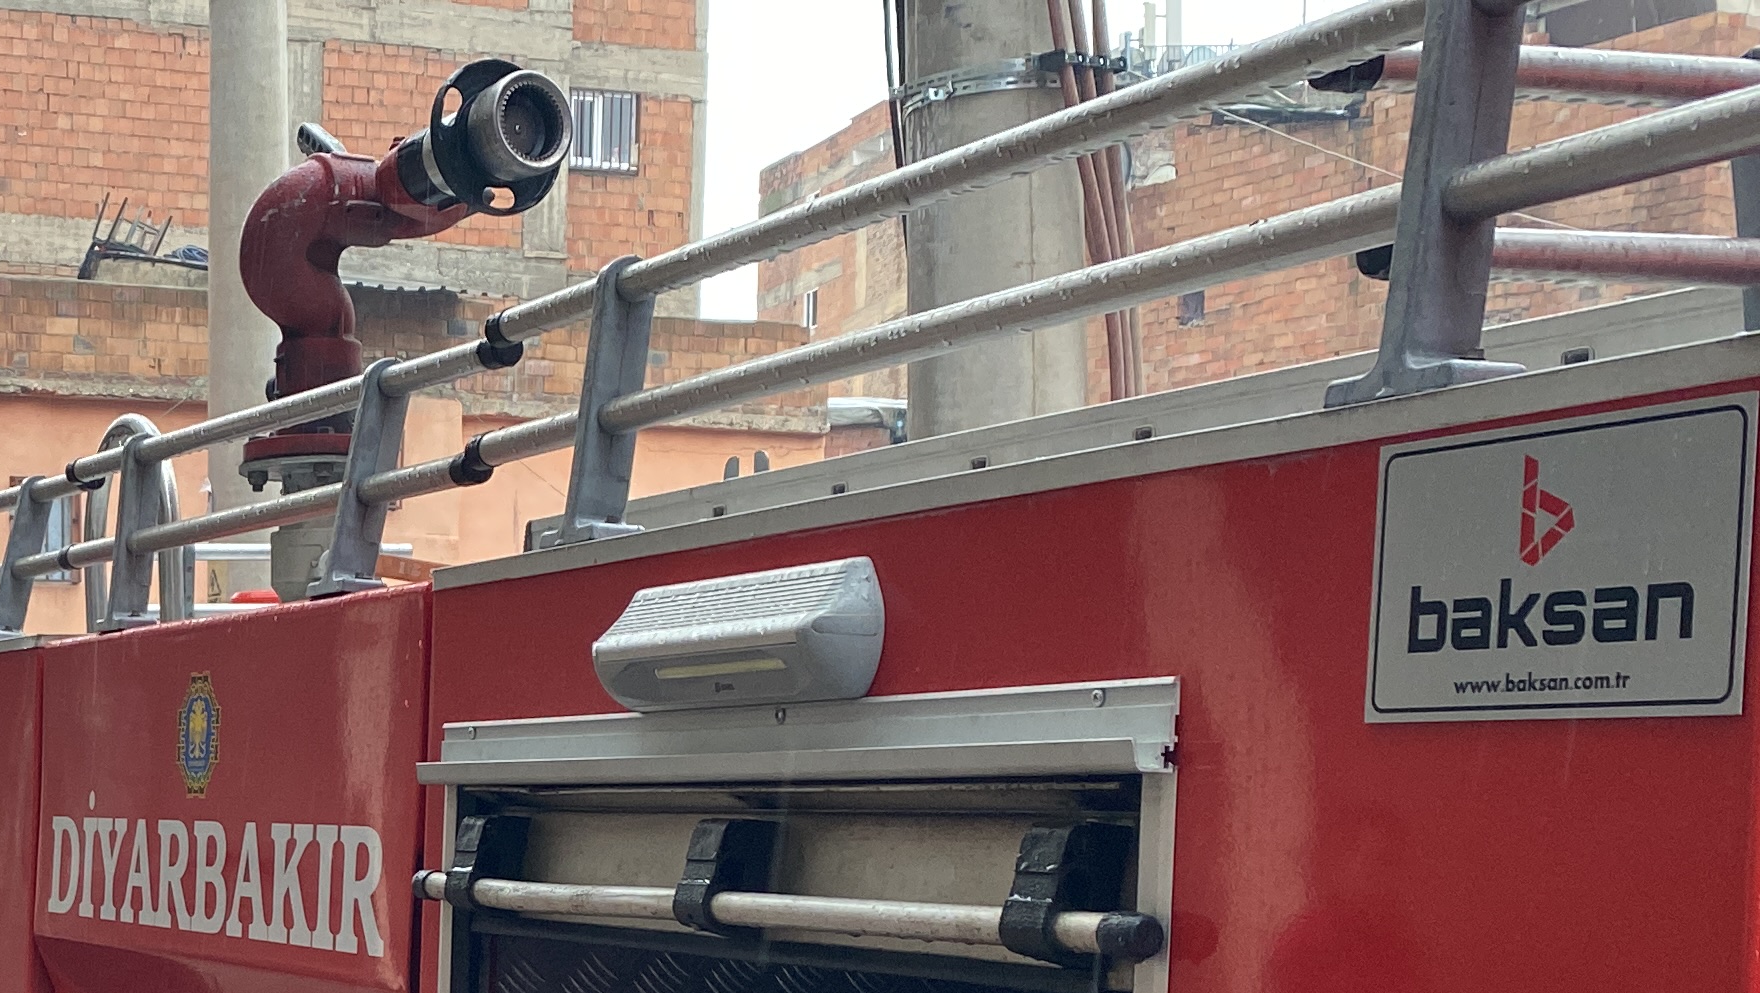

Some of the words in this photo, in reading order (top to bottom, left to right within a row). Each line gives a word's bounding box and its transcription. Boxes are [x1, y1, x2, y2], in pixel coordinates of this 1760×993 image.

[1407, 577, 1694, 654] baksan
[1454, 671, 1631, 694] www.baksan.com.tr
[47, 789, 385, 957] DİYARBAKIR
